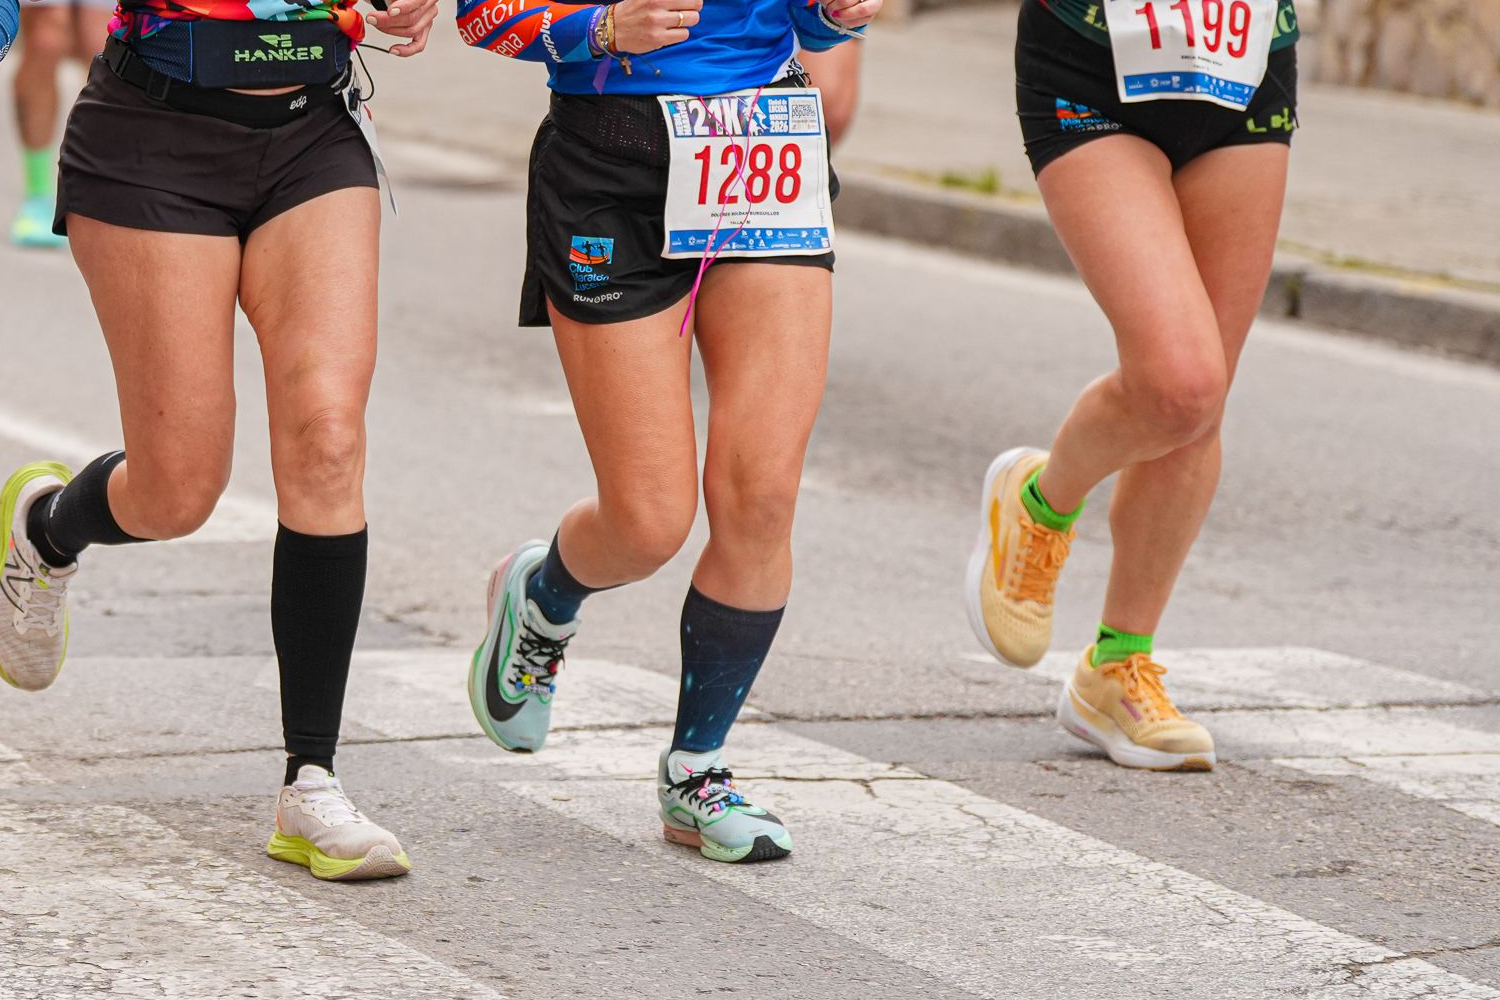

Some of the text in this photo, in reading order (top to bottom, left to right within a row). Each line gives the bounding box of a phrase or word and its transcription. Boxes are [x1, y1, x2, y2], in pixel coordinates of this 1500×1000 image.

[234, 45, 324, 62] HANKER
[689, 99, 743, 137] 21K
[770, 120, 789, 133] 2026
[694, 143, 802, 205] 1288
[569, 263, 593, 273] Club
